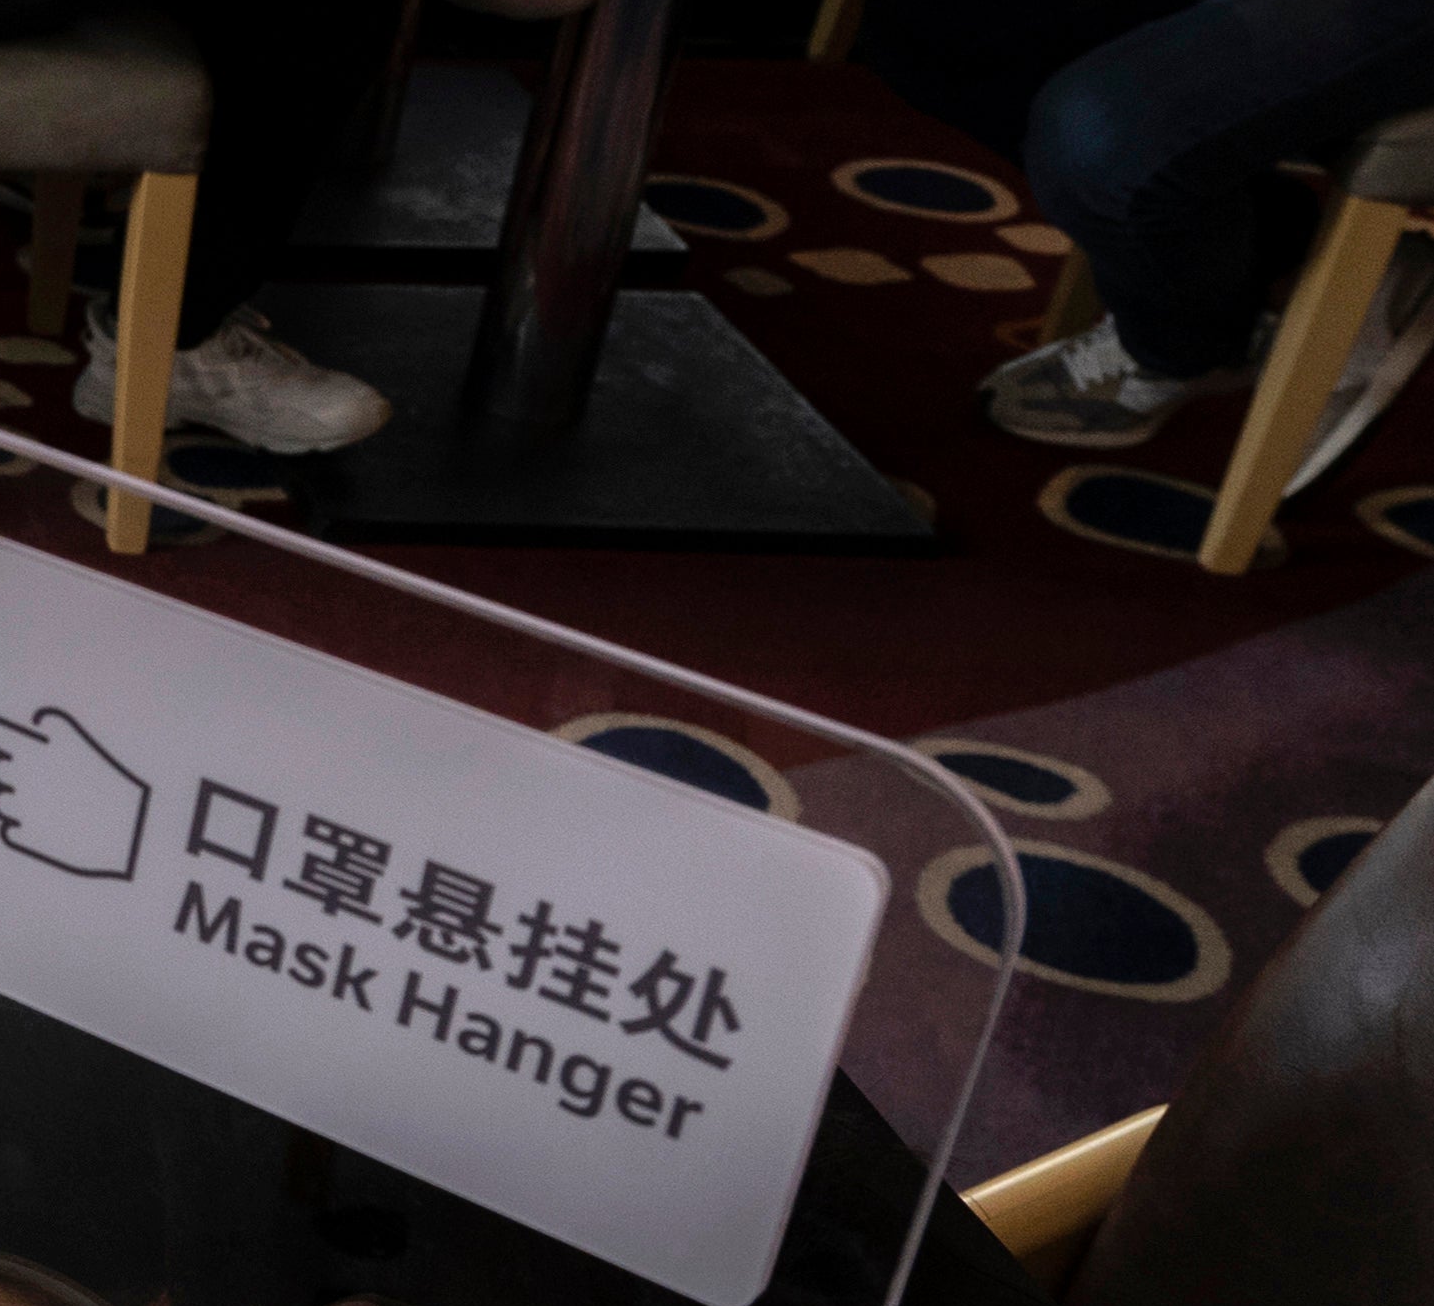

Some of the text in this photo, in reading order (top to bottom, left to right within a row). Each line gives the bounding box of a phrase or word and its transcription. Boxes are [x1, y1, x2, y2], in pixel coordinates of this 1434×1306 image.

[171, 880, 707, 1142] Mask Hanger
[183, 776, 743, 1073] 口罩悬挂处
